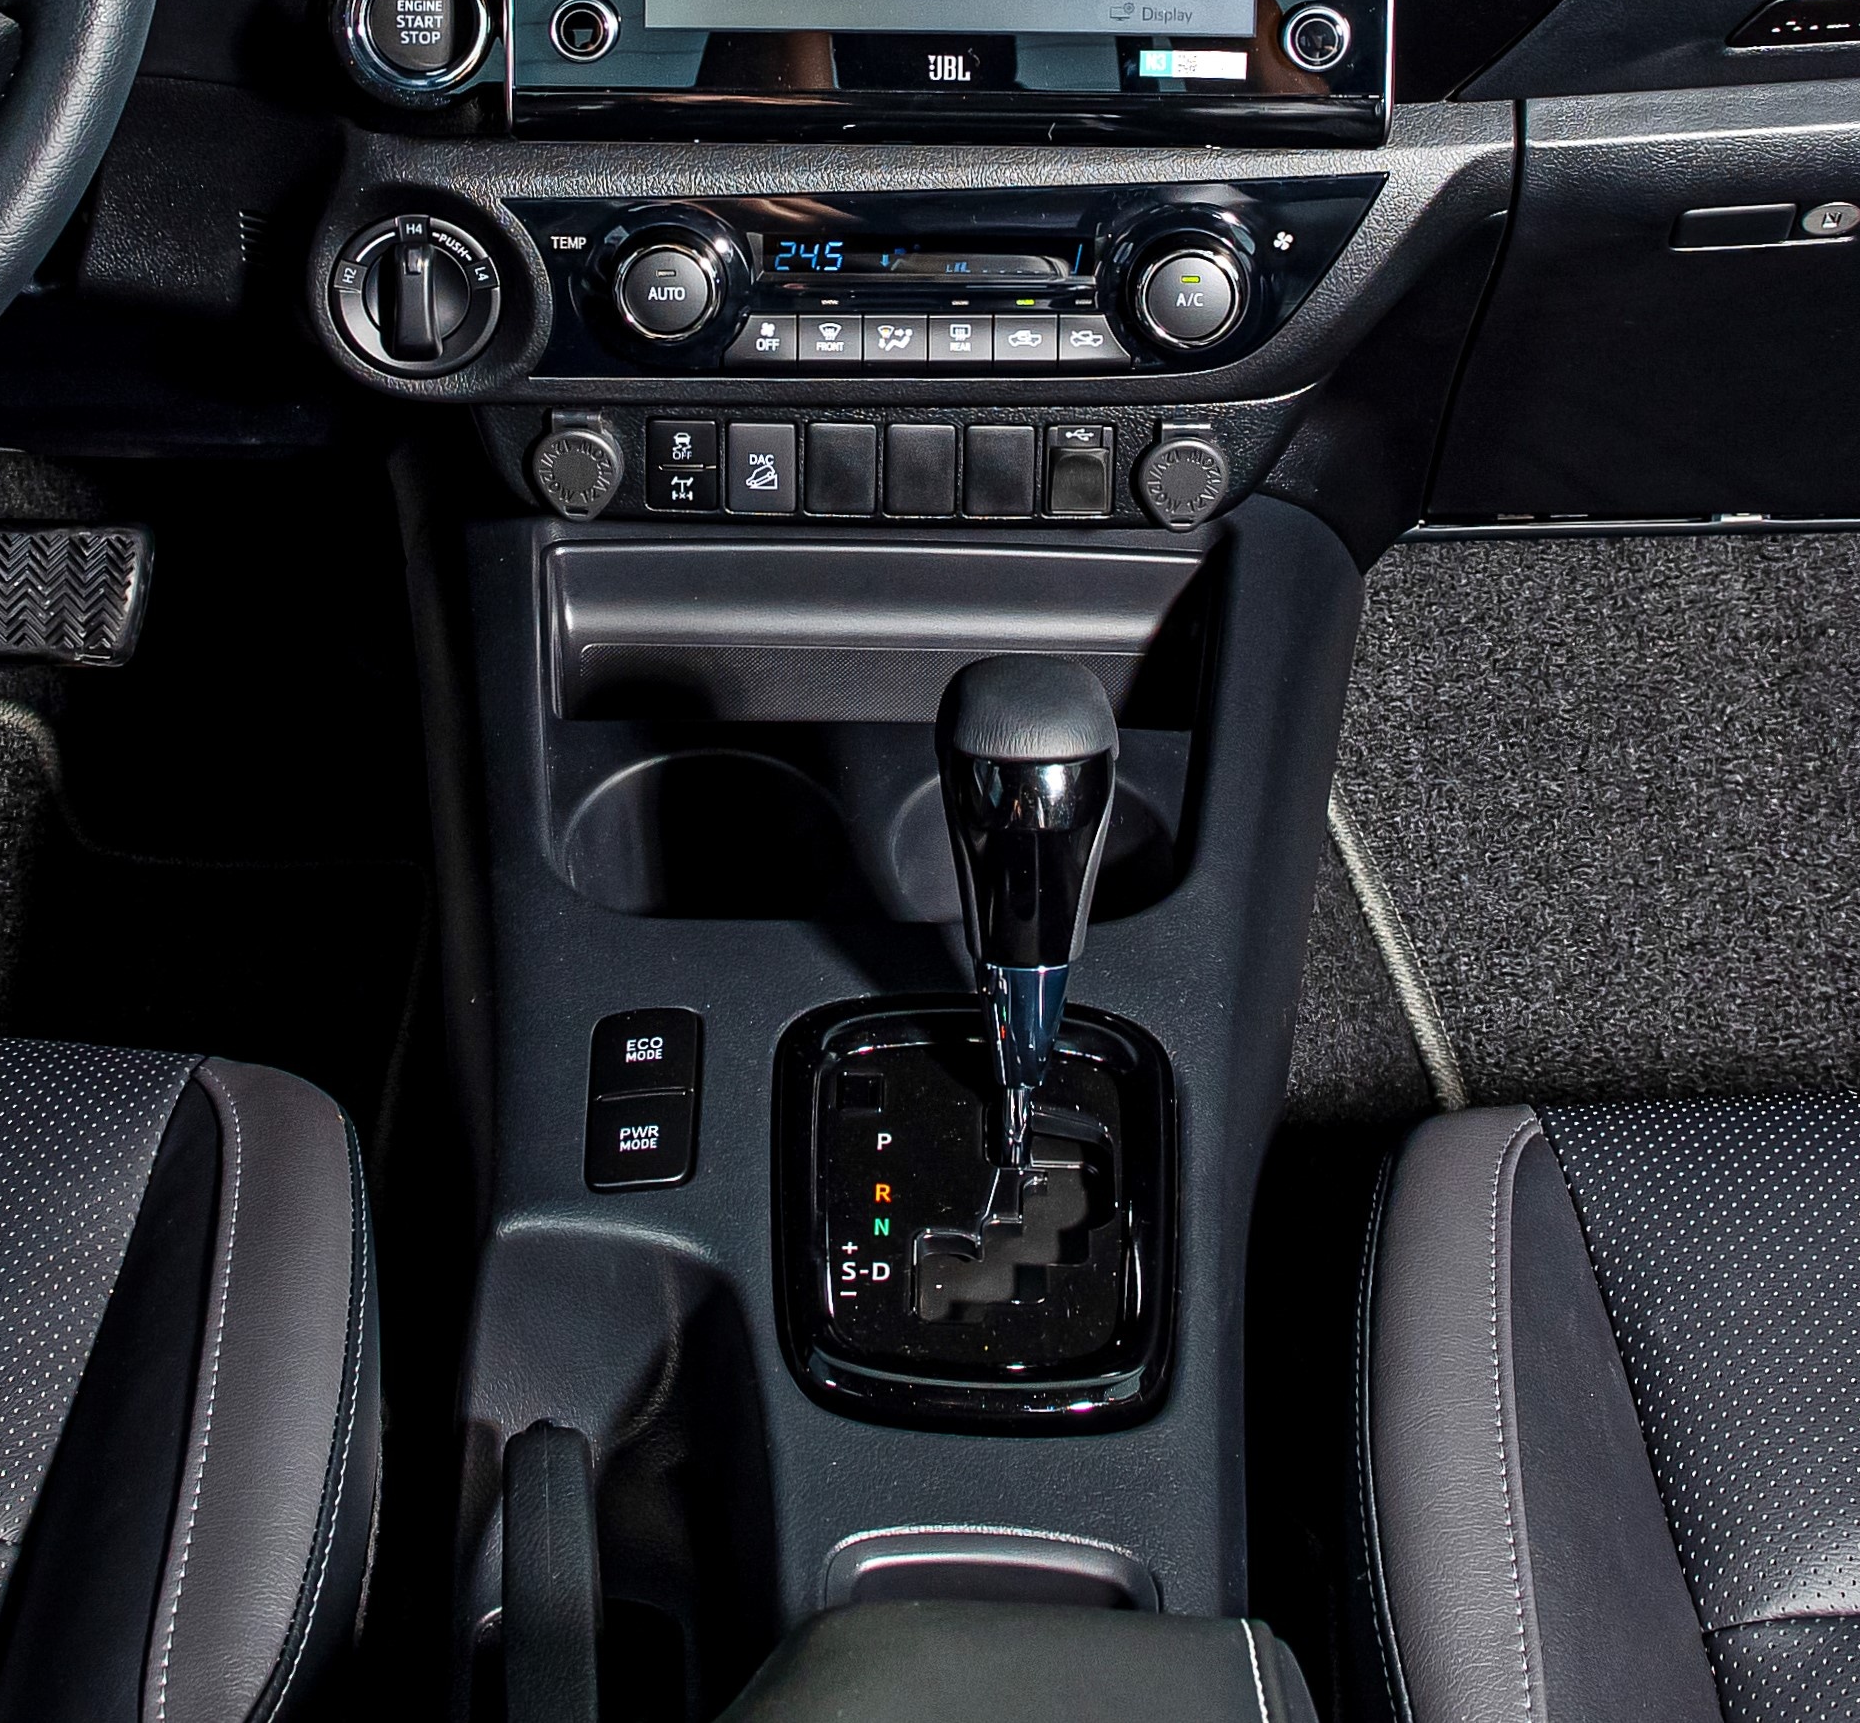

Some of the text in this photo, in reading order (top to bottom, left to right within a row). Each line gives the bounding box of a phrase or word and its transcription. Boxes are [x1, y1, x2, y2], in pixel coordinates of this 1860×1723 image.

[396, 0, 443, 12] ENGINE
[396, 15, 444, 28] START
[1141, 6, 1193, 24] Display
[400, 30, 441, 45] STOP
[927, 54, 971, 81] JBL
[405, 223, 423, 235] H4
[438, 233, 469, 259] PUSH
[550, 236, 587, 249] TEMP
[774, 241, 844, 272] 24.5
[342, 267, 357, 283] H2
[473, 266, 489, 282] L4
[647, 286, 686, 302] AUTO
[1175, 292, 1204, 307] A/C
[755, 338, 780, 352] OFF
[816, 341, 845, 353] FRONT
[949, 341, 972, 353] REAR
[672, 449, 692, 460] OFF
[749, 453, 775, 466] DAC
[626, 1036, 663, 1052] ECO
[625, 1049, 663, 1063] MODE
[619, 1125, 659, 1140] PWR
[619, 1137, 658, 1152] MODE
[876, 1132, 892, 1151] P
[874, 1183, 892, 1203] R
[874, 1217, 890, 1237] N
